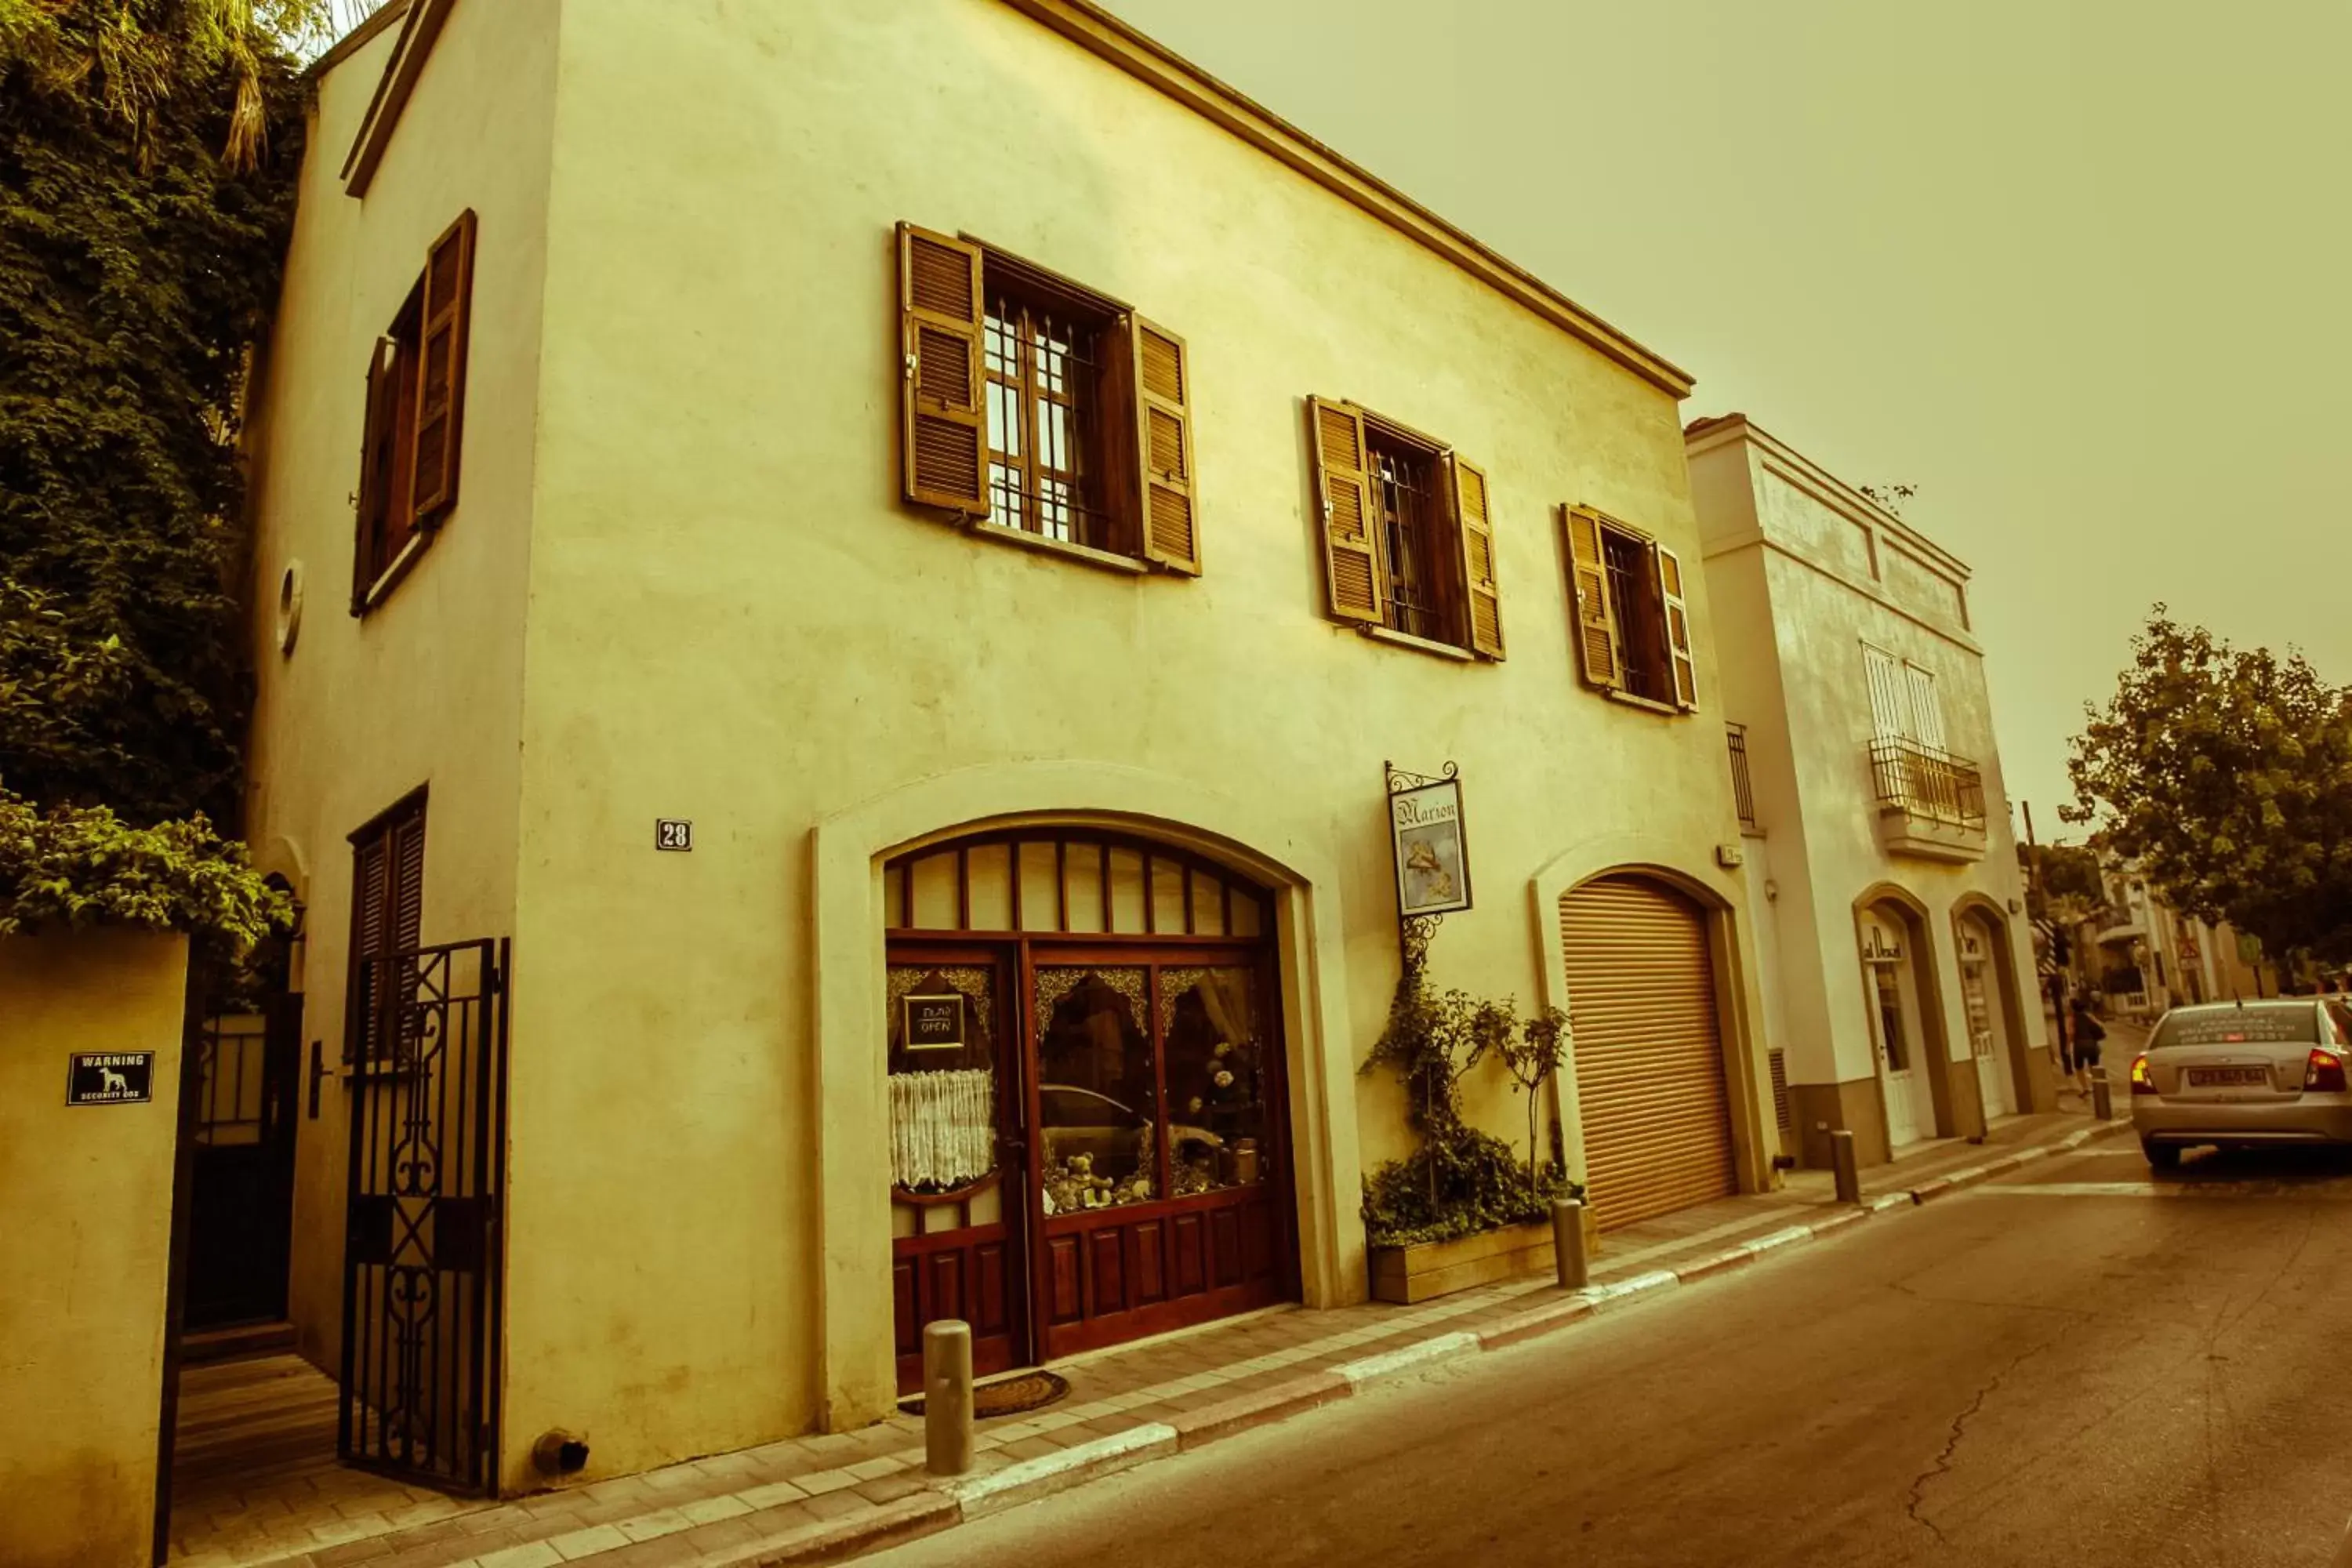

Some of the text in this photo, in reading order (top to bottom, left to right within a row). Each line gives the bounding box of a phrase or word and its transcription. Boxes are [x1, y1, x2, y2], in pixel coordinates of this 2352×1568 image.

[1397, 797, 1456, 825] Marion
[663, 823, 686, 846] 28
[921, 1022, 951, 1033] OPEN
[82, 1054, 144, 1067] WARNING
[81, 1091, 121, 1100] SECURITY
